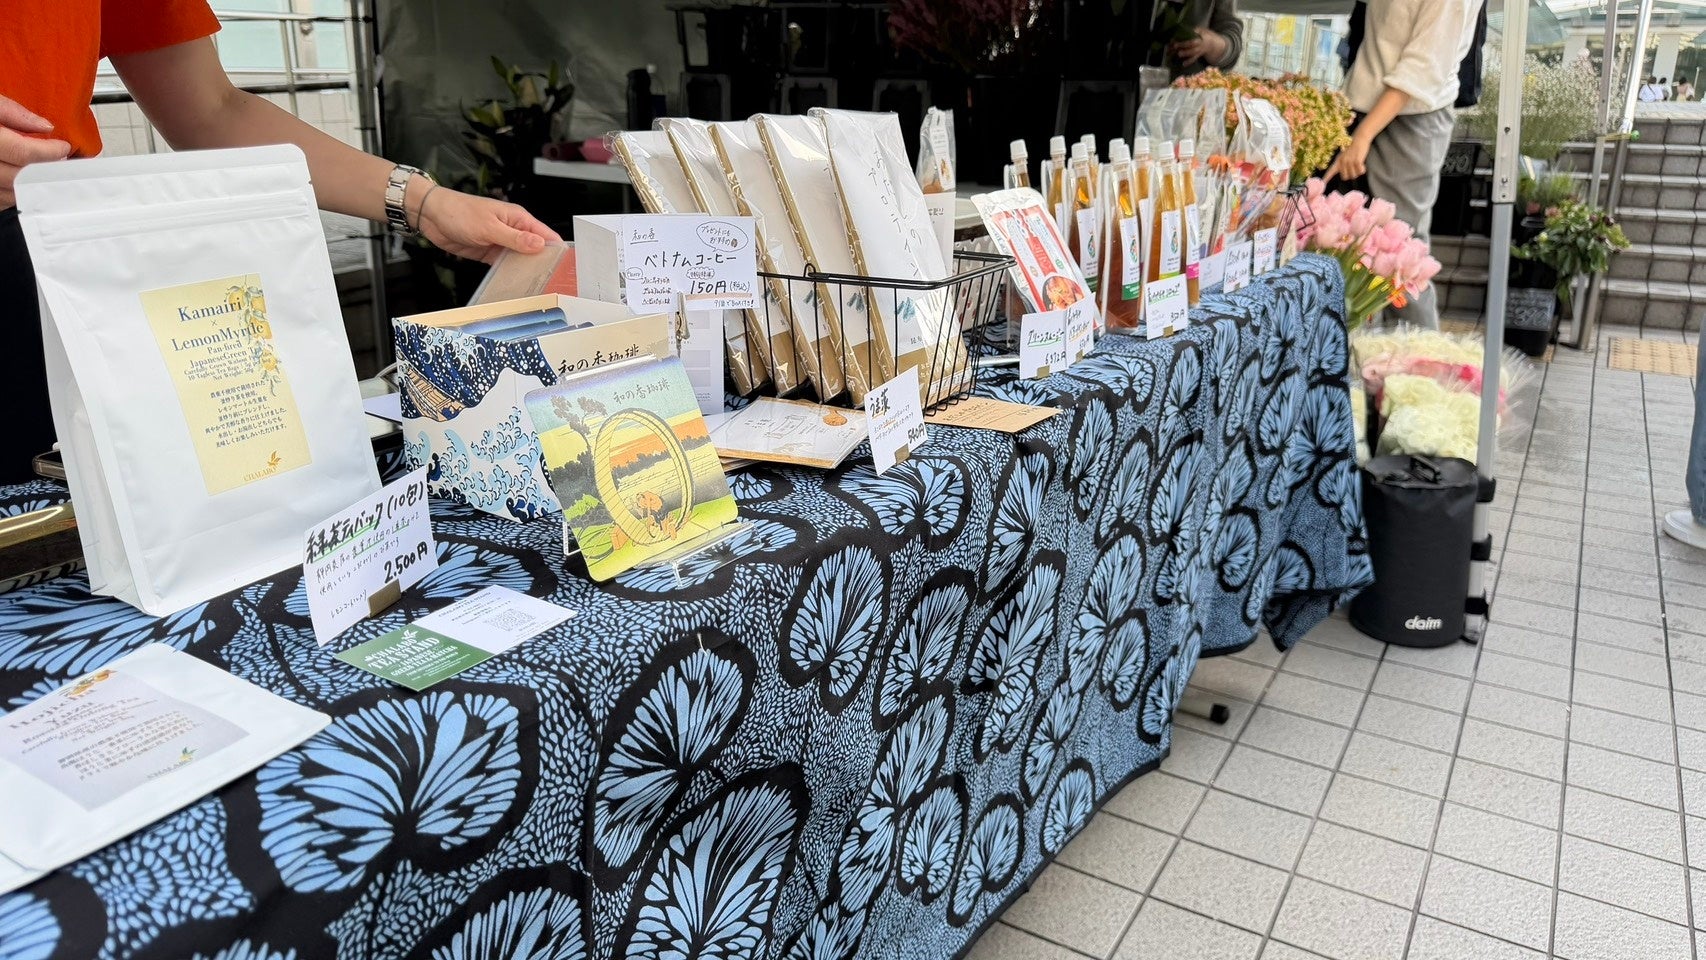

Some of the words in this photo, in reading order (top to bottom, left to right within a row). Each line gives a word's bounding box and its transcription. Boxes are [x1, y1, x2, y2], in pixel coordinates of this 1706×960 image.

[644, 251, 737, 267] ベトナムコーヒー
[690, 280, 727, 295] 150円
[178, 297, 242, 321] Kamairi
[171, 322, 264, 351] LemonMyrtle
[613, 377, 671, 404] 和の香珈琲
[1405, 615, 1443, 631] daim
